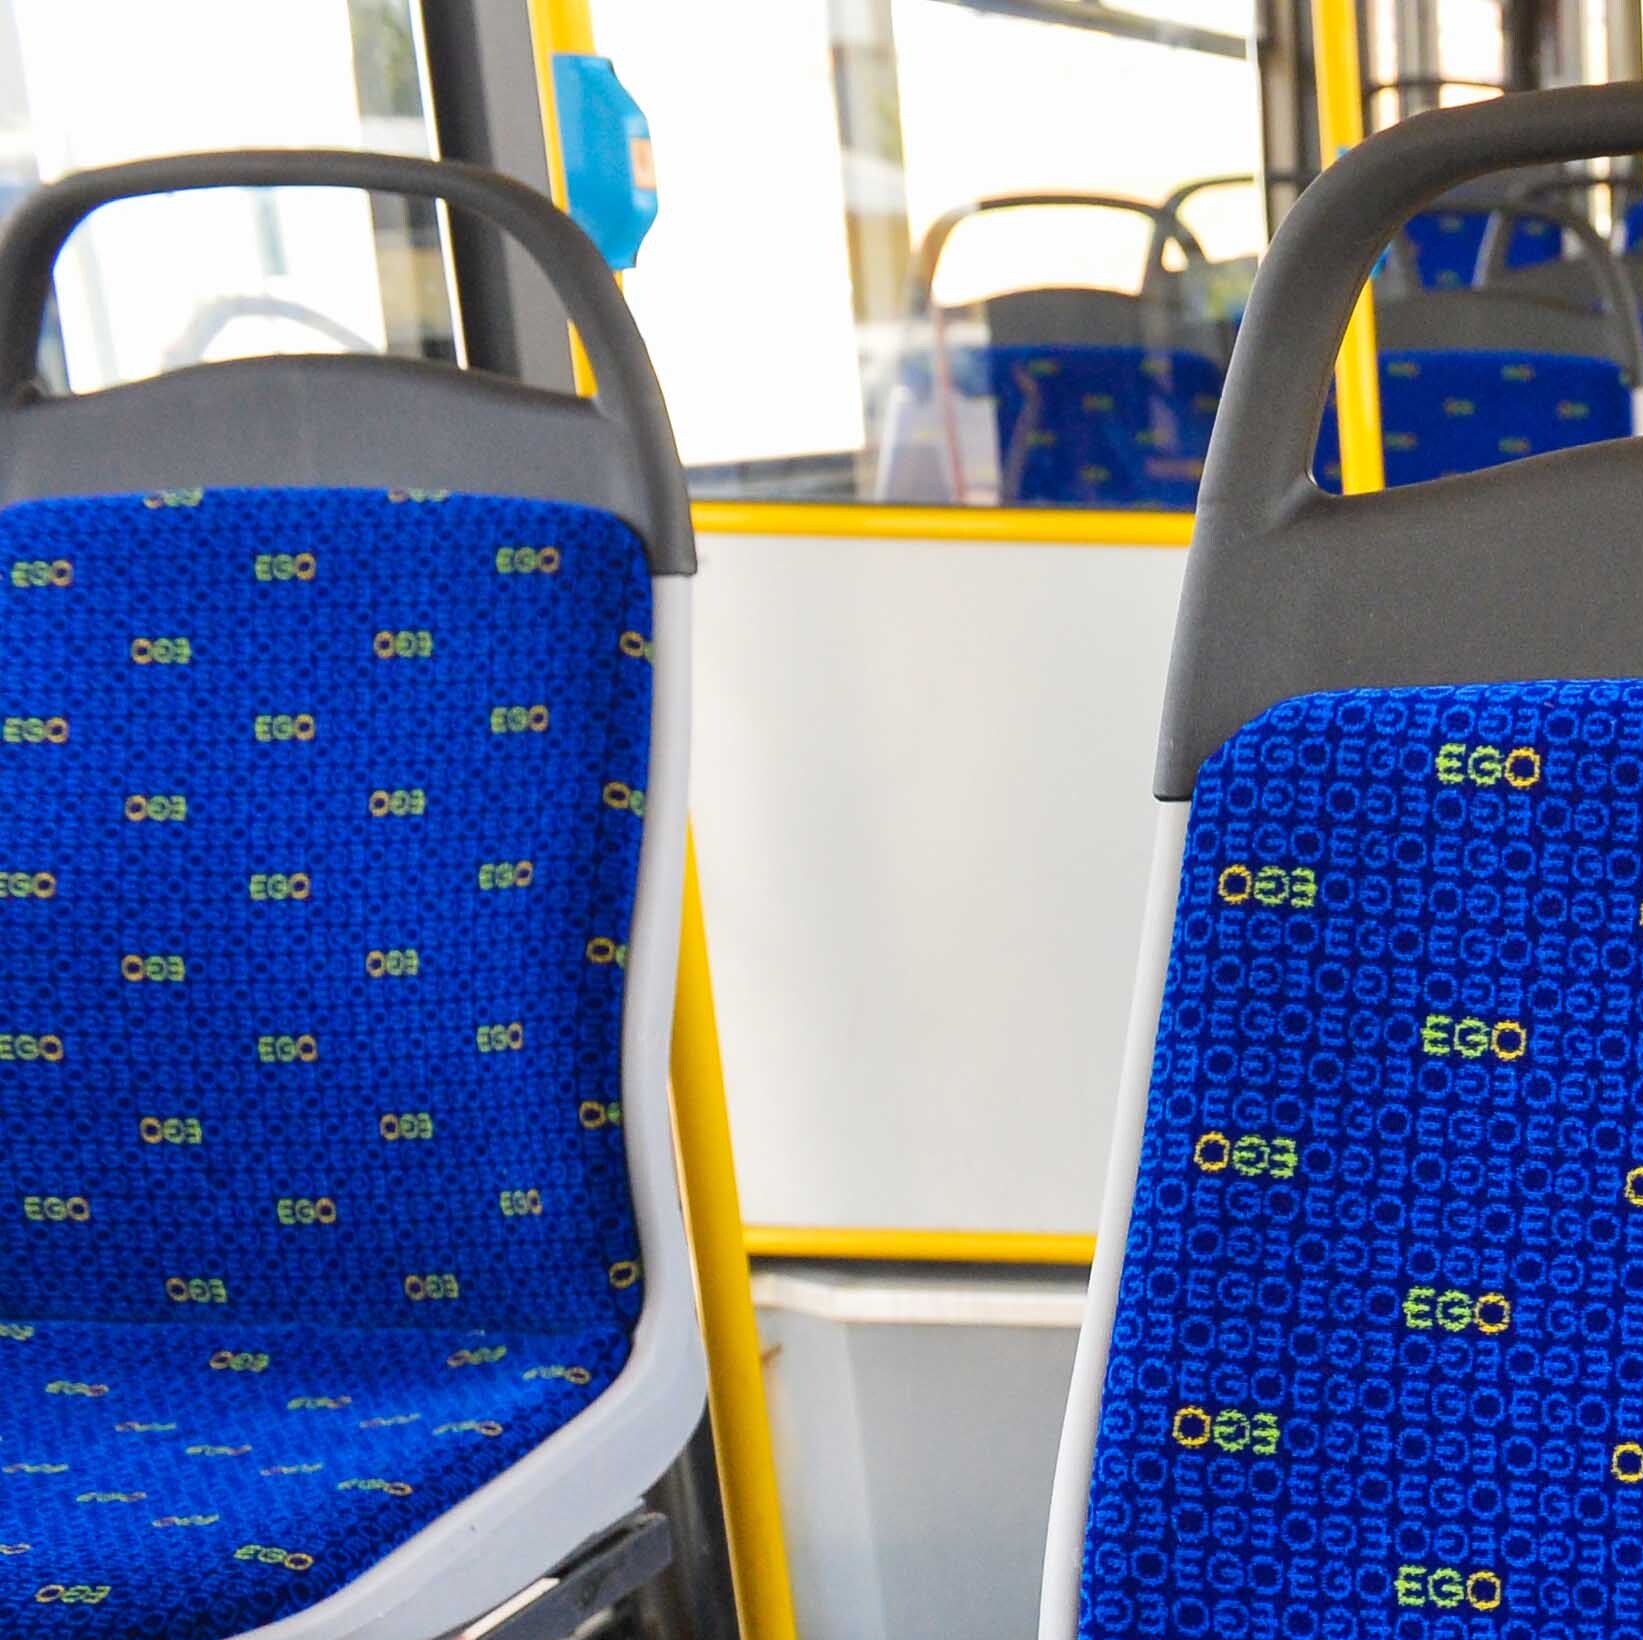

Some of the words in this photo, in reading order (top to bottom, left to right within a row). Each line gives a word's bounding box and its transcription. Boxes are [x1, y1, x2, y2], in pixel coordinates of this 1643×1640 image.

[11, 558, 71, 587] EGO
[254, 713, 314, 741] EGO
[490, 705, 547, 733] EGO
[1437, 744, 1540, 788] EGO
[249, 873, 309, 900] EGO
[478, 861, 532, 889] EGO
[258, 1034, 316, 1062] EGO
[476, 1022, 522, 1052] EGO
[1422, 1015, 1526, 1060] EGO
[1403, 1287, 1509, 1333] EGO
[1396, 1566, 1500, 1610] EGO
